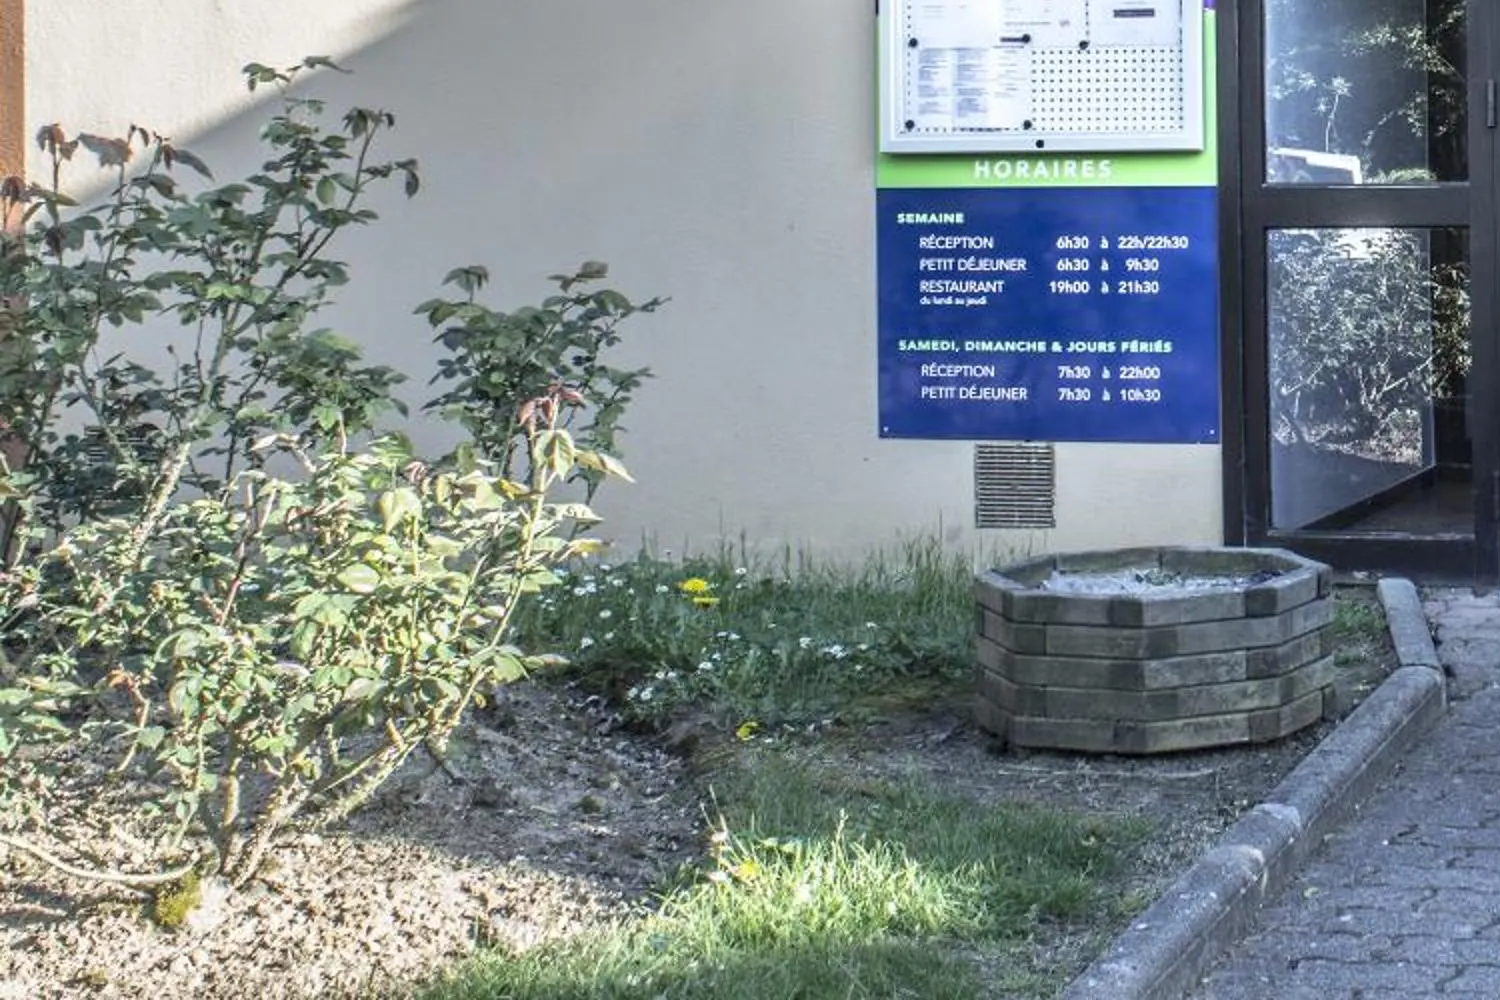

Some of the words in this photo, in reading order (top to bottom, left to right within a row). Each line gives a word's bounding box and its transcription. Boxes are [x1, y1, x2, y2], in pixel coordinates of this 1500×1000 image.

[974, 160, 1112, 180] HORAIRES
[897, 212, 964, 224] SEMAINE
[919, 233, 994, 249] RÉCEPTION
[1056, 235, 1089, 249] 6h30
[1117, 235, 1189, 249] 22h/22h30
[919, 258, 955, 271] PETIT
[957, 256, 1027, 271] DÉJEUNER
[1056, 257, 1089, 271] 6h30
[1125, 257, 1159, 271] 9h30
[919, 280, 1005, 293] RESTAURANT
[1049, 280, 1090, 293] 19h00
[1117, 280, 1159, 293] 21h30
[898, 340, 960, 352] SAMEDI,
[965, 341, 1047, 353] DIMANCHE
[1067, 341, 1117, 353] JOURS
[1121, 339, 1173, 353] FÉRIÉS
[921, 362, 995, 377] RÉCEPTION
[1058, 365, 1091, 379] 7h30
[1119, 365, 1161, 379] 22h00
[921, 386, 957, 399] PETIT
[959, 384, 1028, 400] DÉJEUNER
[1058, 387, 1091, 401] 7h30
[1119, 387, 1161, 401] 10h30
